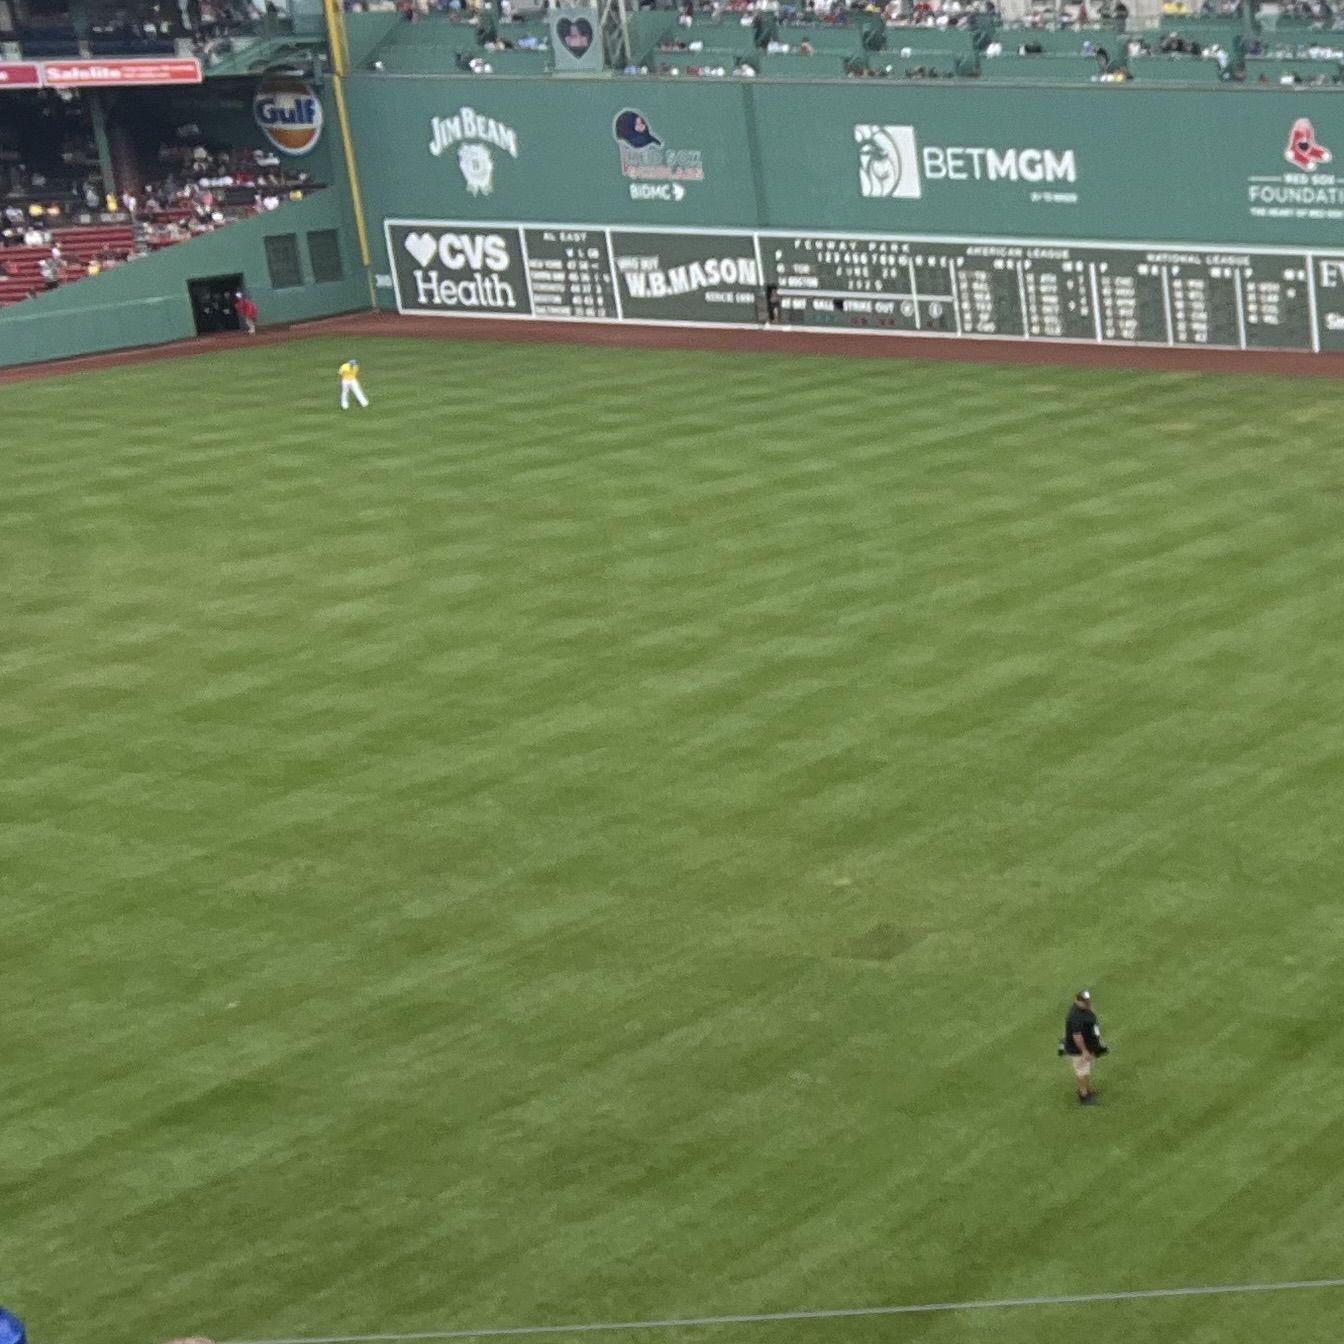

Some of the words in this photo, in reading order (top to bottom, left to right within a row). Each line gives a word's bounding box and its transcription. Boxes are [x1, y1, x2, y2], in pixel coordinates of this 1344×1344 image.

[257, 97, 316, 125] Gulf
[429, 115, 461, 157] JIM
[459, 105, 518, 159] BEAM
[923, 146, 1076, 183] BETMGM
[629, 182, 672, 201] BIDMC
[438, 233, 509, 272] CVS
[868, 242, 910, 254] PARK
[415, 269, 517, 308] Health
[624, 256, 758, 298] W.B.MASON
